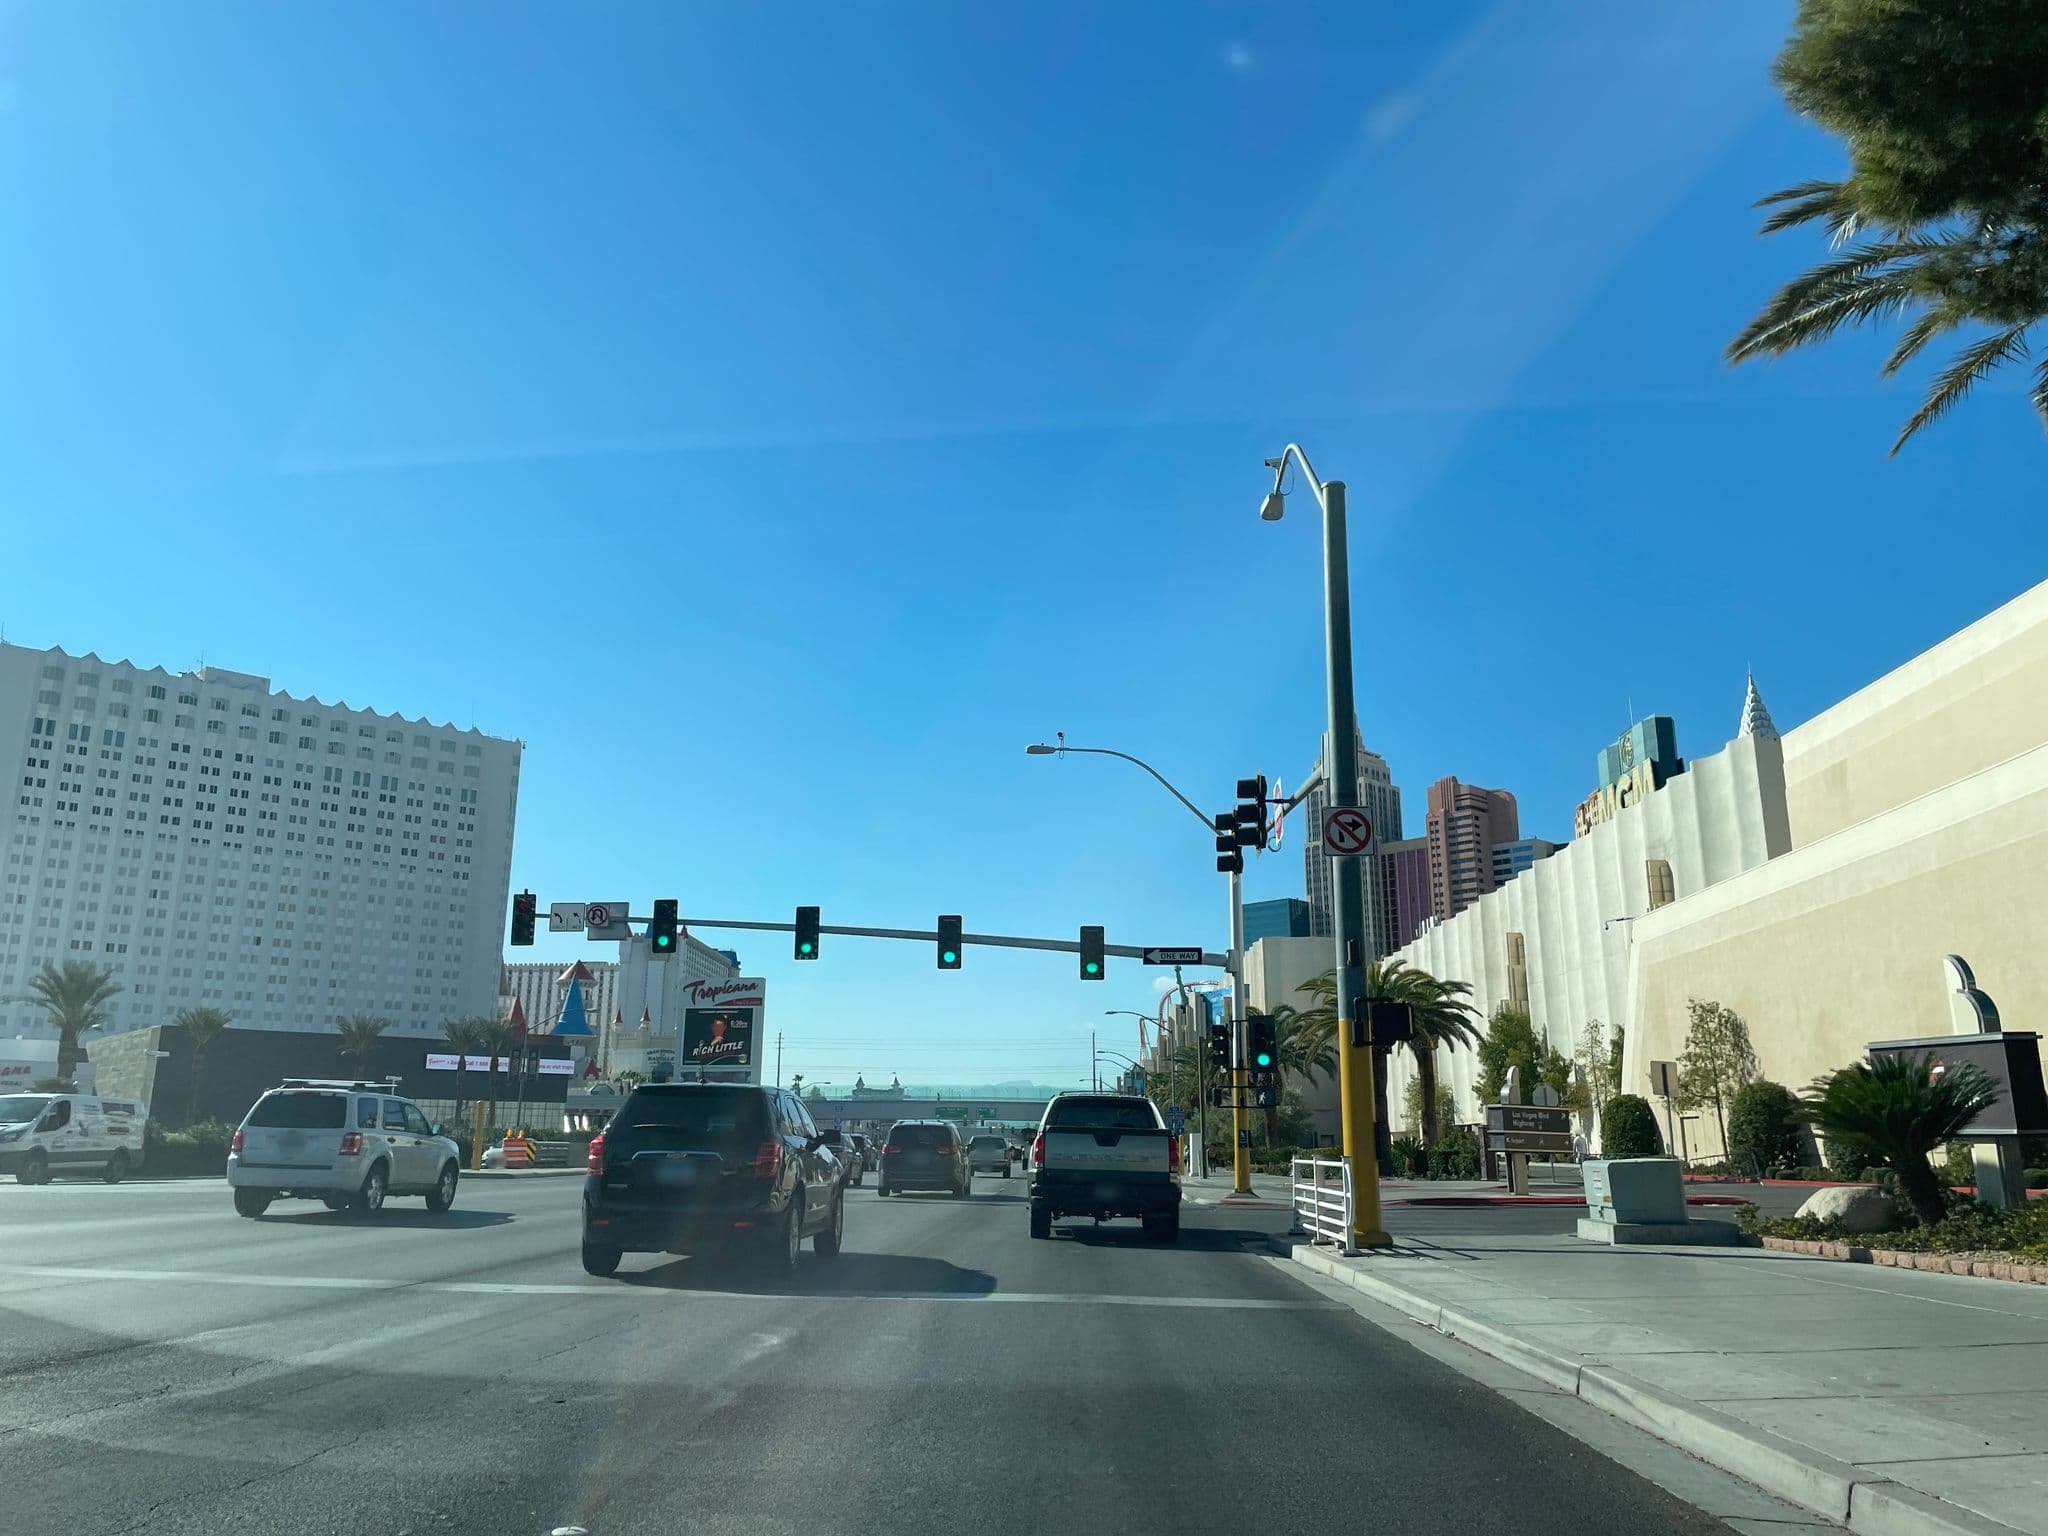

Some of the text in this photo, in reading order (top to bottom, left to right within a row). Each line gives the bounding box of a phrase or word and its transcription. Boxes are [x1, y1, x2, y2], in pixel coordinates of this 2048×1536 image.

[1160, 952, 1196, 960] ONE WAY
[683, 979, 758, 1006] Tropicana
[692, 1041, 744, 1056] RICH LITTLE
[1522, 1111, 1537, 1120] Vegas
